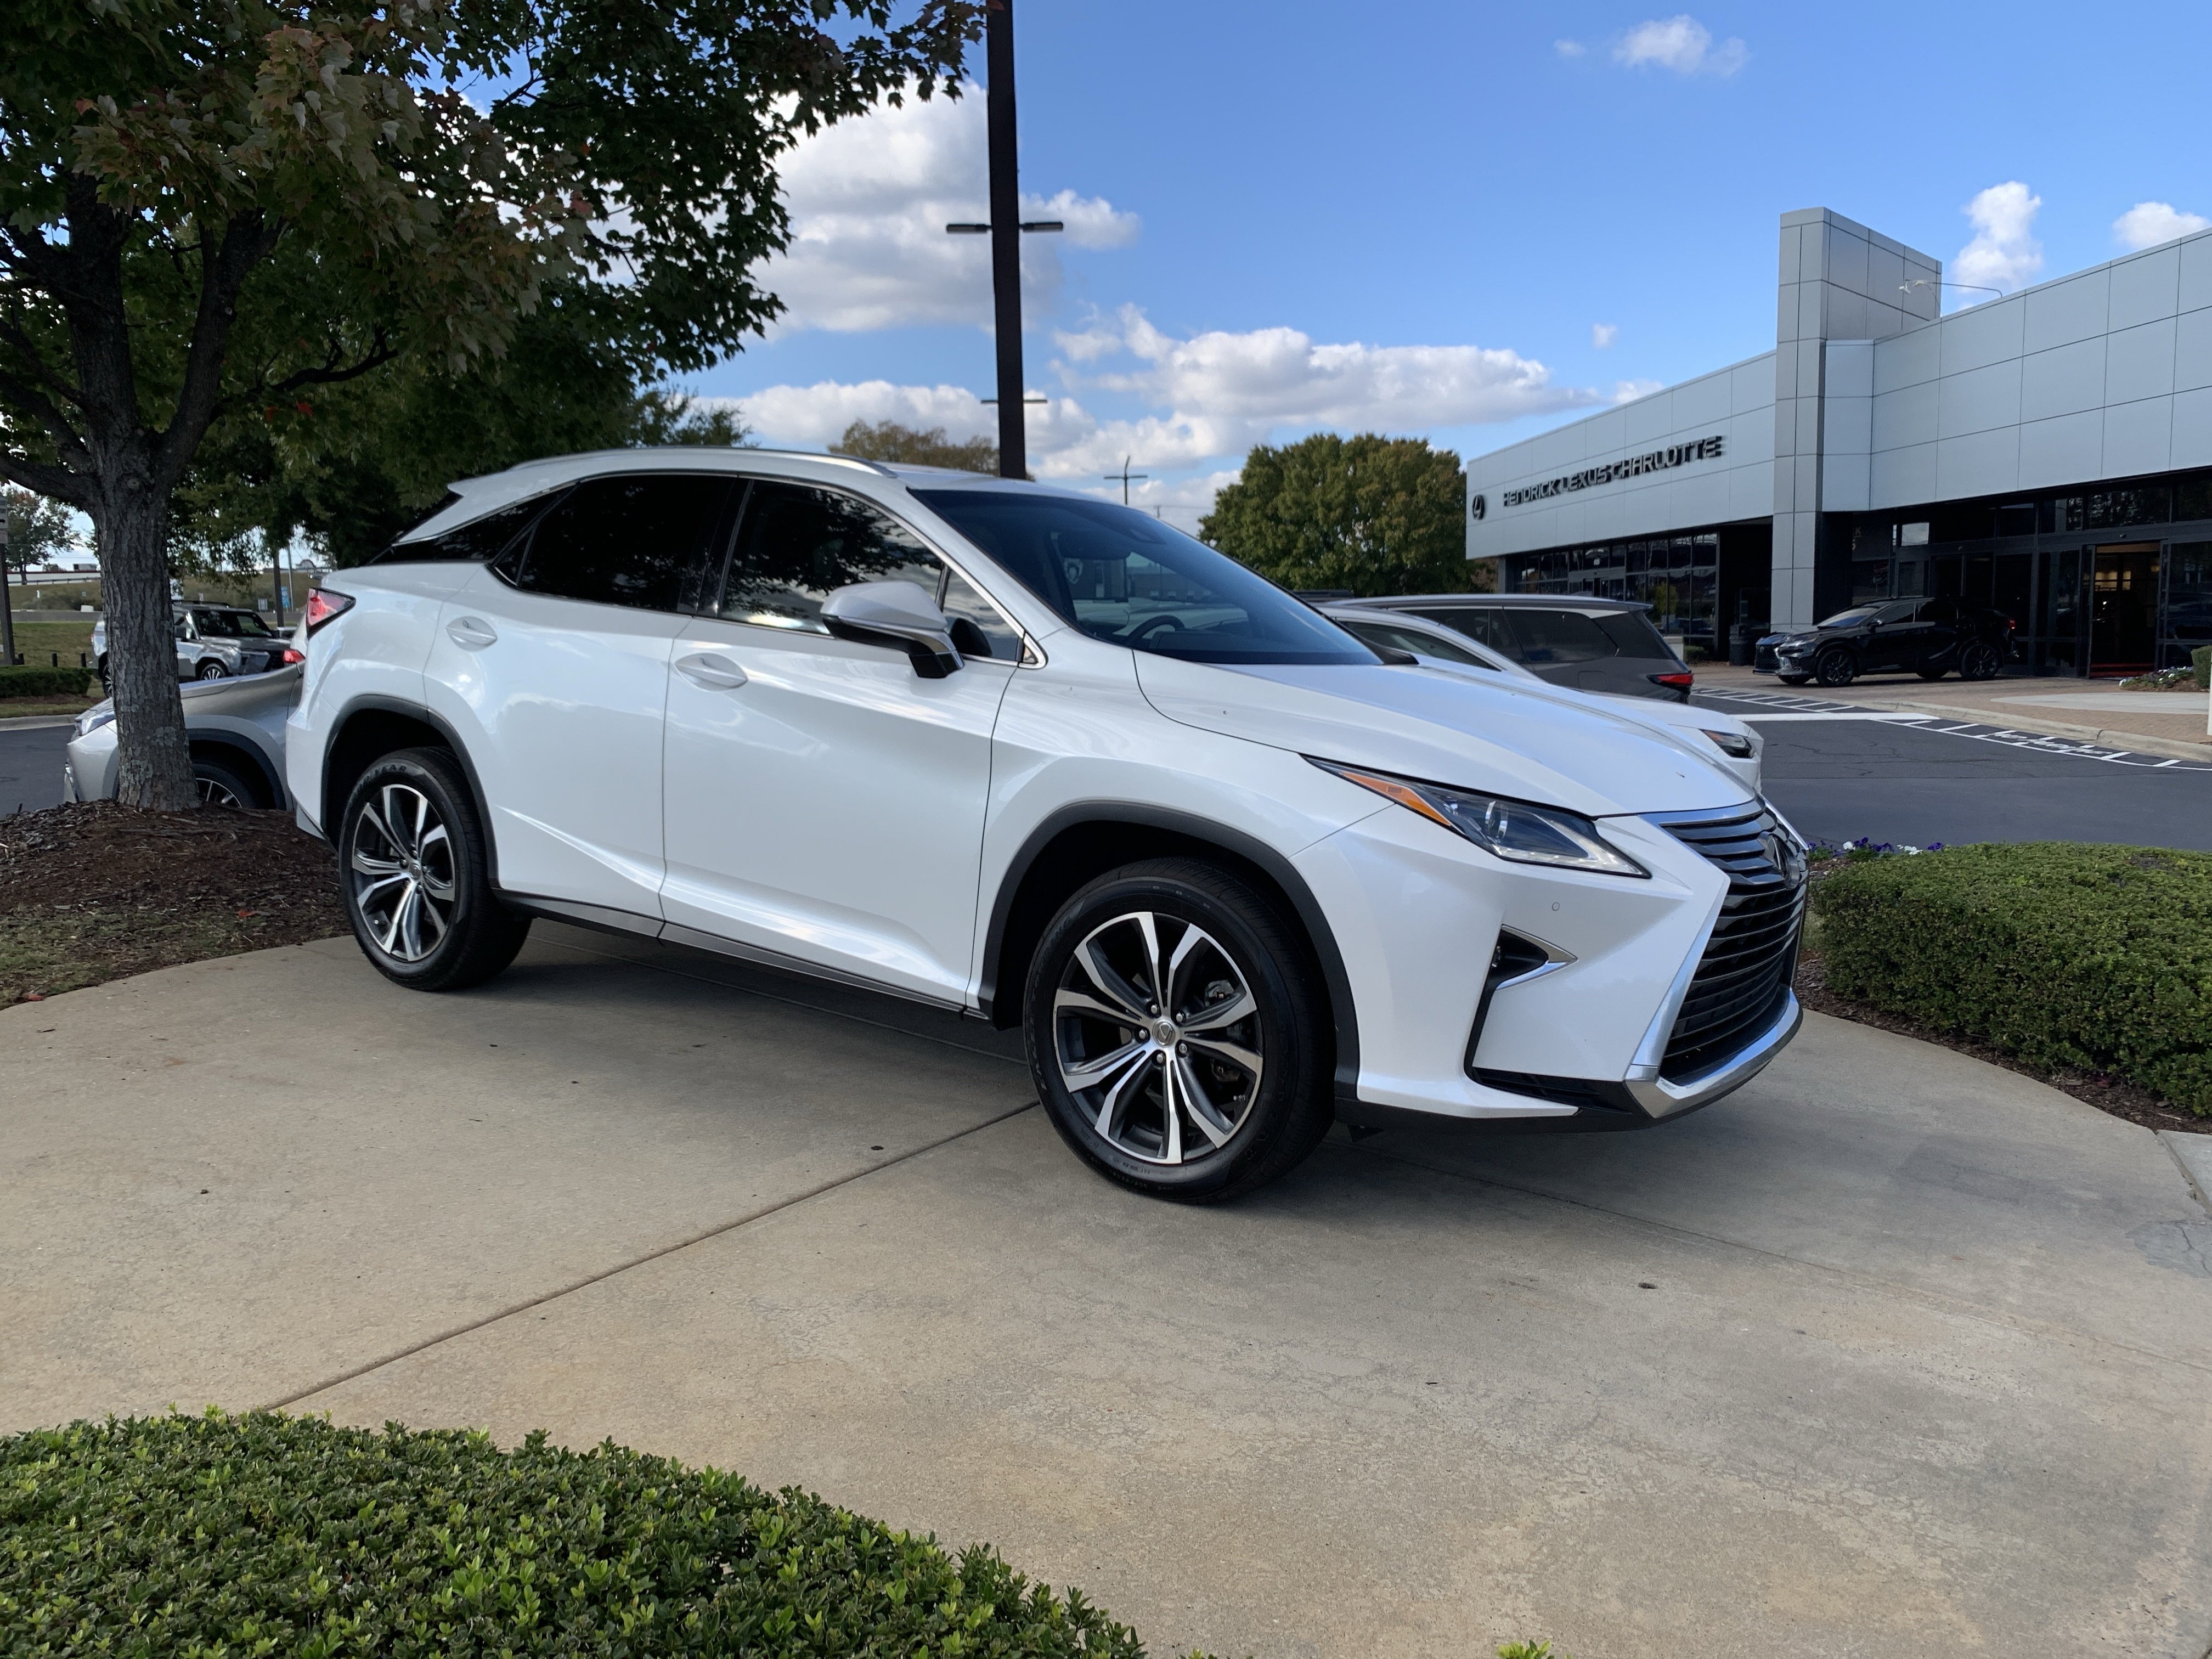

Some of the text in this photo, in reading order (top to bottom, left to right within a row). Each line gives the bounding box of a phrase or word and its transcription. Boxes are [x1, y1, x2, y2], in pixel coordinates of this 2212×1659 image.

[1503, 436, 1723, 507] HENDRICK LEXUS CHARLOTTE
